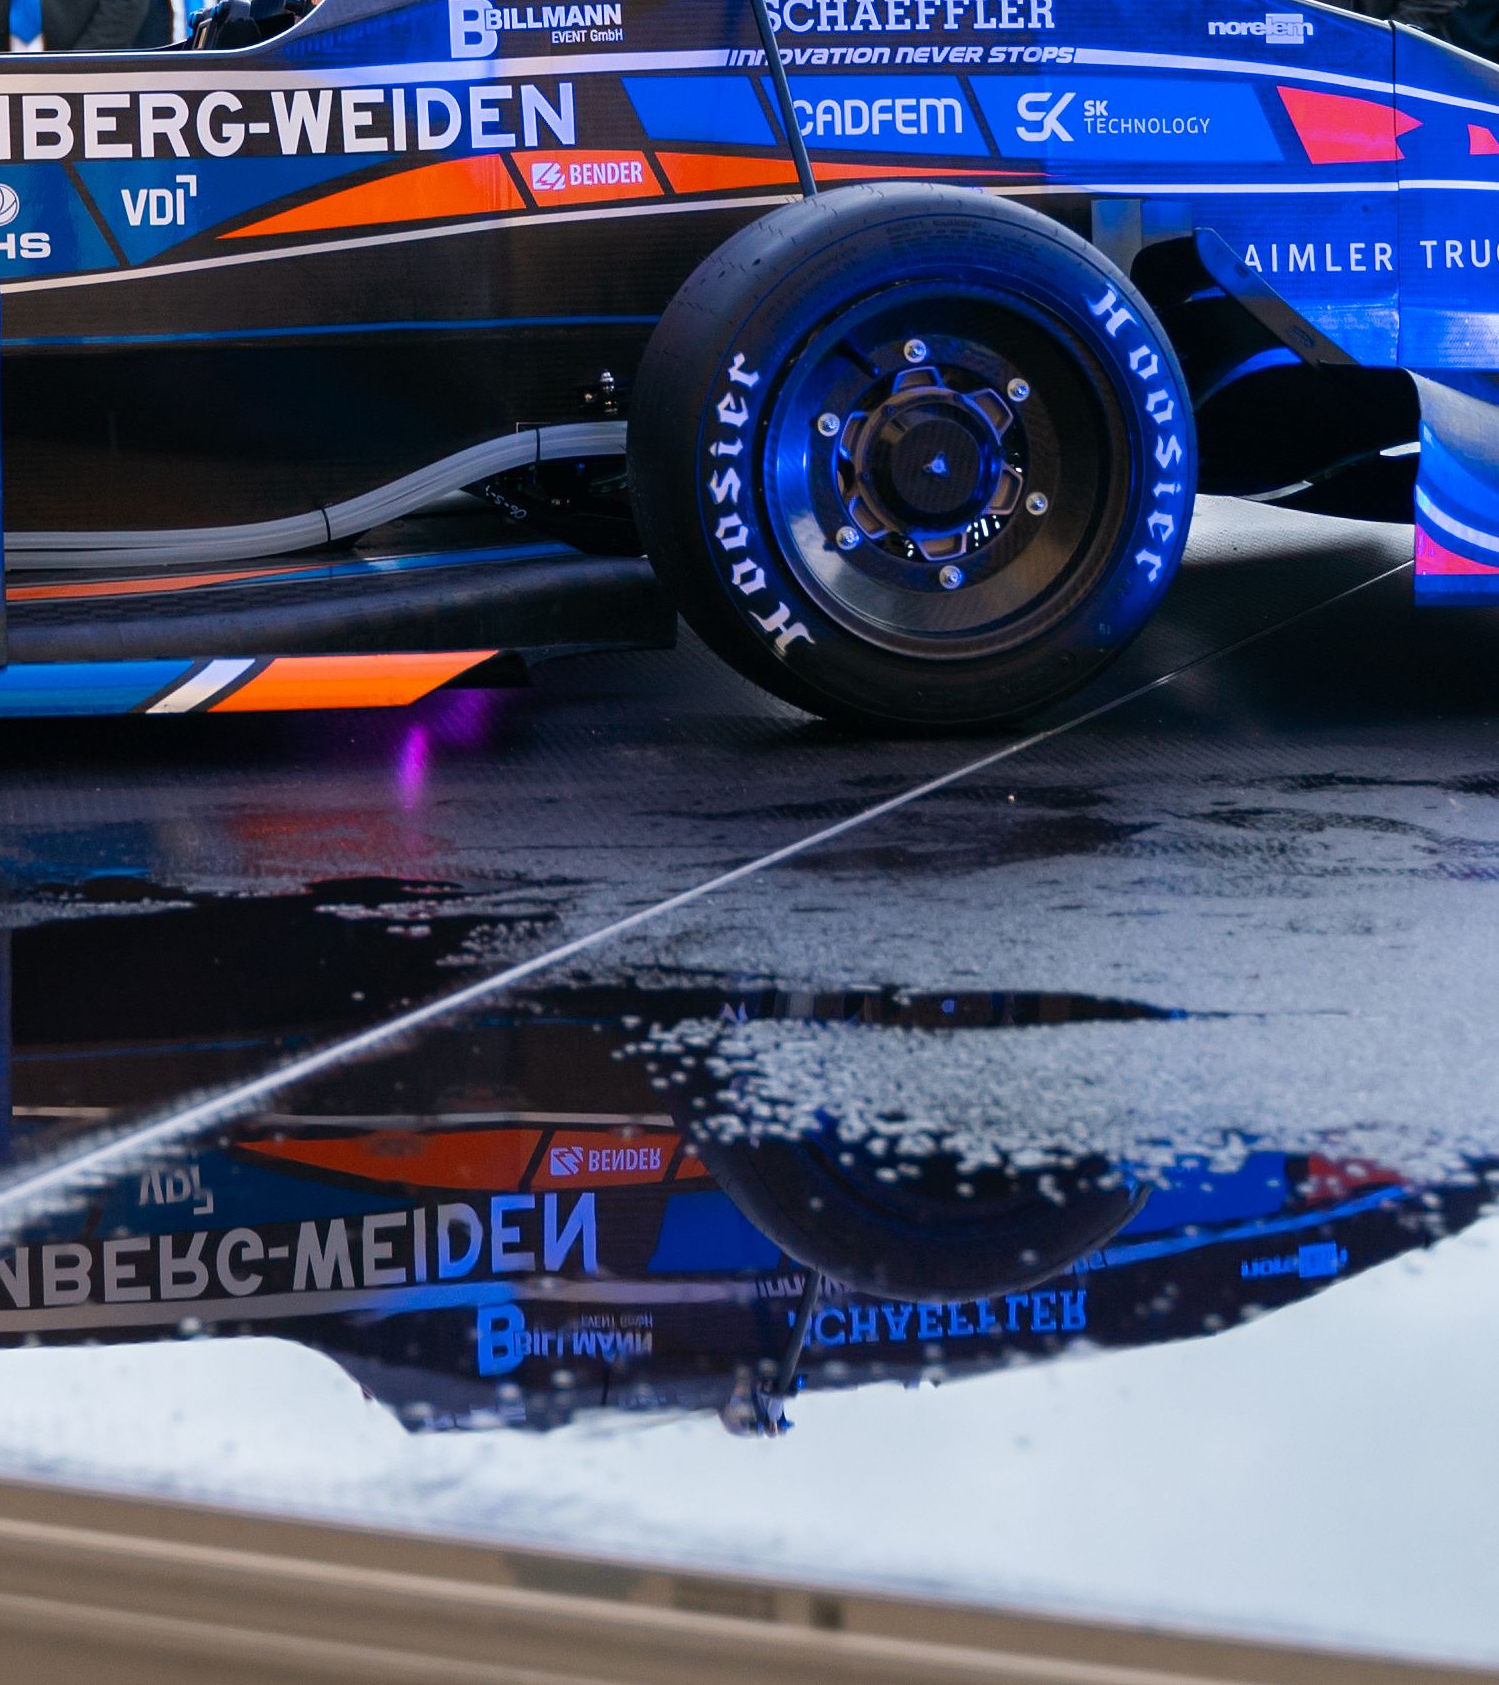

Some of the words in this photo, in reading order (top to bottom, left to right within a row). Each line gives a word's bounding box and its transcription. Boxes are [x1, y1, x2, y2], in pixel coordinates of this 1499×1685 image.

[485, 2, 623, 32] BILLMANN
[1207, 14, 1315, 41] norelem
[550, 30, 591, 44] EVENT
[593, 28, 624, 43] GmbH
[987, 46, 1073, 64] STOPS
[792, 97, 963, 137] CADFEM
[1084, 100, 1109, 116] SK
[1084, 116, 1211, 137] TECHNOLOGY
[568, 161, 643, 187] BENDER
[120, 185, 189, 228] VDI
[1242, 240, 1394, 273] AIMLER
[1084, 281, 1184, 585] Hoosier
[709, 351, 816, 657] Hoosier
